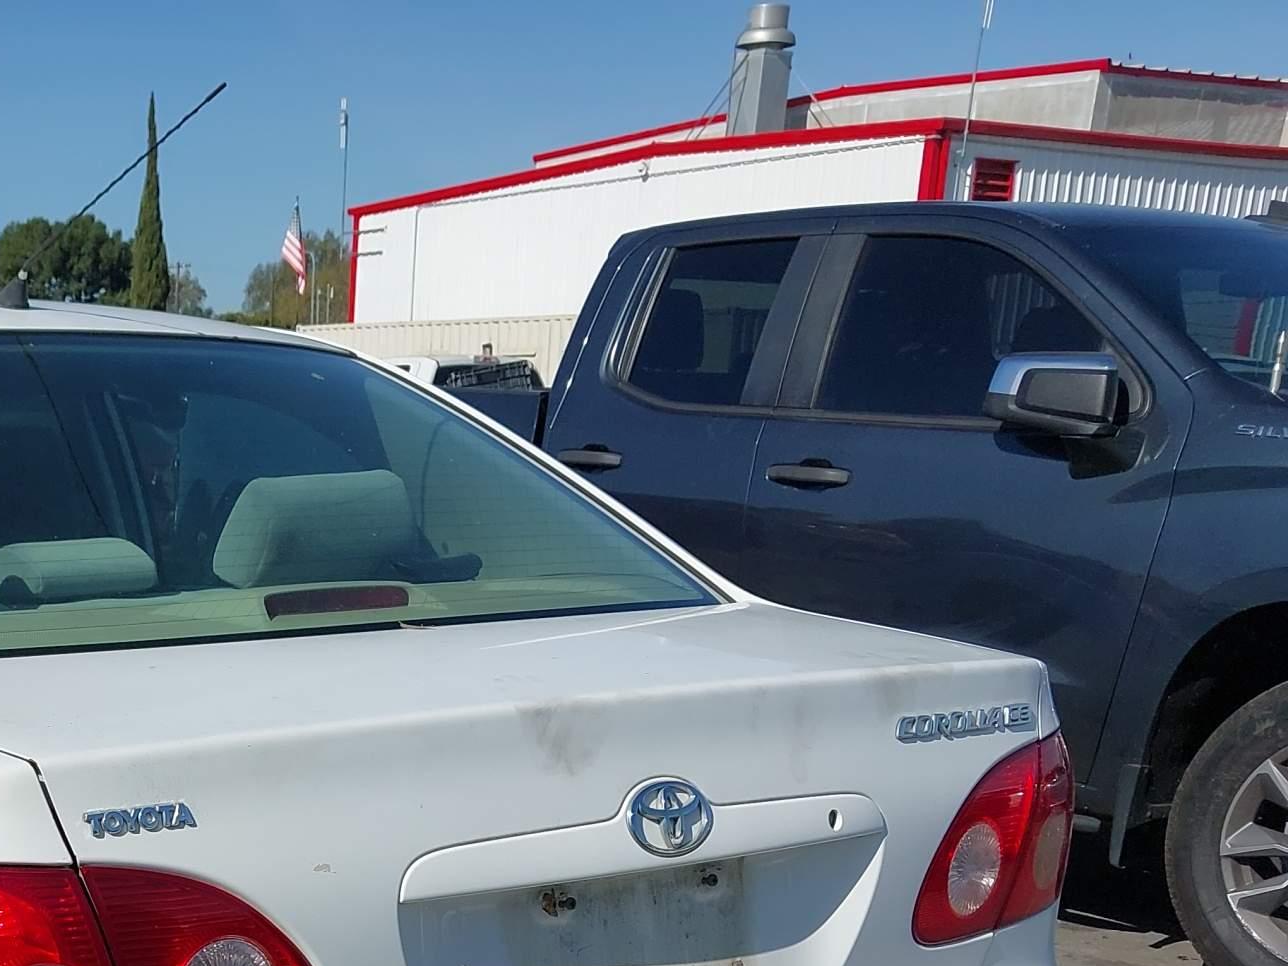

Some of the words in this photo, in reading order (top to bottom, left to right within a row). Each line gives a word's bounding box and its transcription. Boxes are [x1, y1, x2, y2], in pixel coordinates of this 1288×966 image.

[896, 707, 1005, 744] COROLLA
[1005, 703, 1035, 731] CE
[83, 801, 197, 839] TOYOTA
